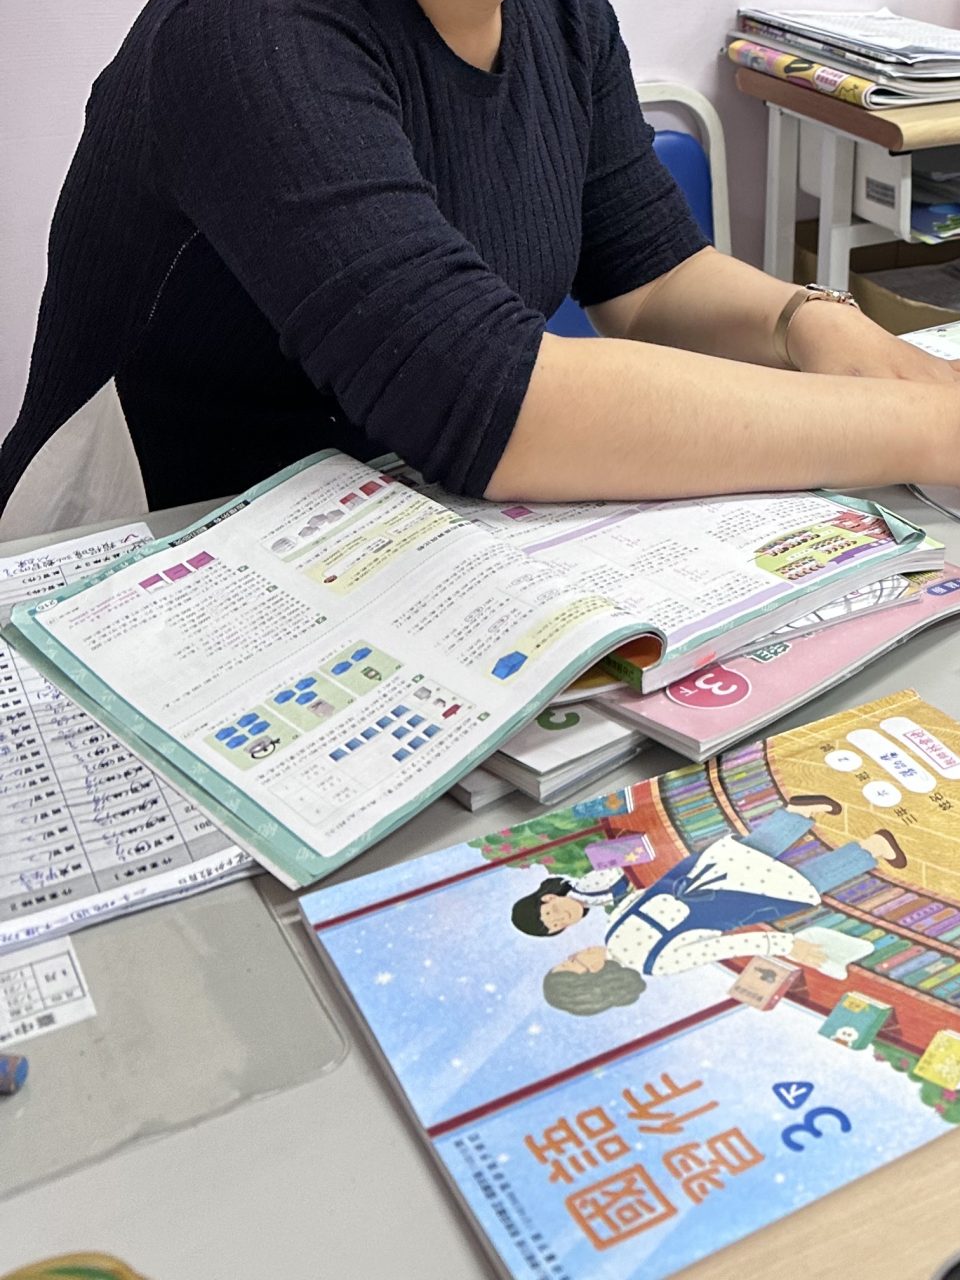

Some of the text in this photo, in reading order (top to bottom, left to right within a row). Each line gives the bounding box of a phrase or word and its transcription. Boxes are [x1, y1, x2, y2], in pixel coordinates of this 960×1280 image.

[697, 672, 737, 699] 3
[623, 1072, 765, 1203] 習作
[781, 1106, 852, 1152] 3
[525, 1105, 678, 1251] 國語
